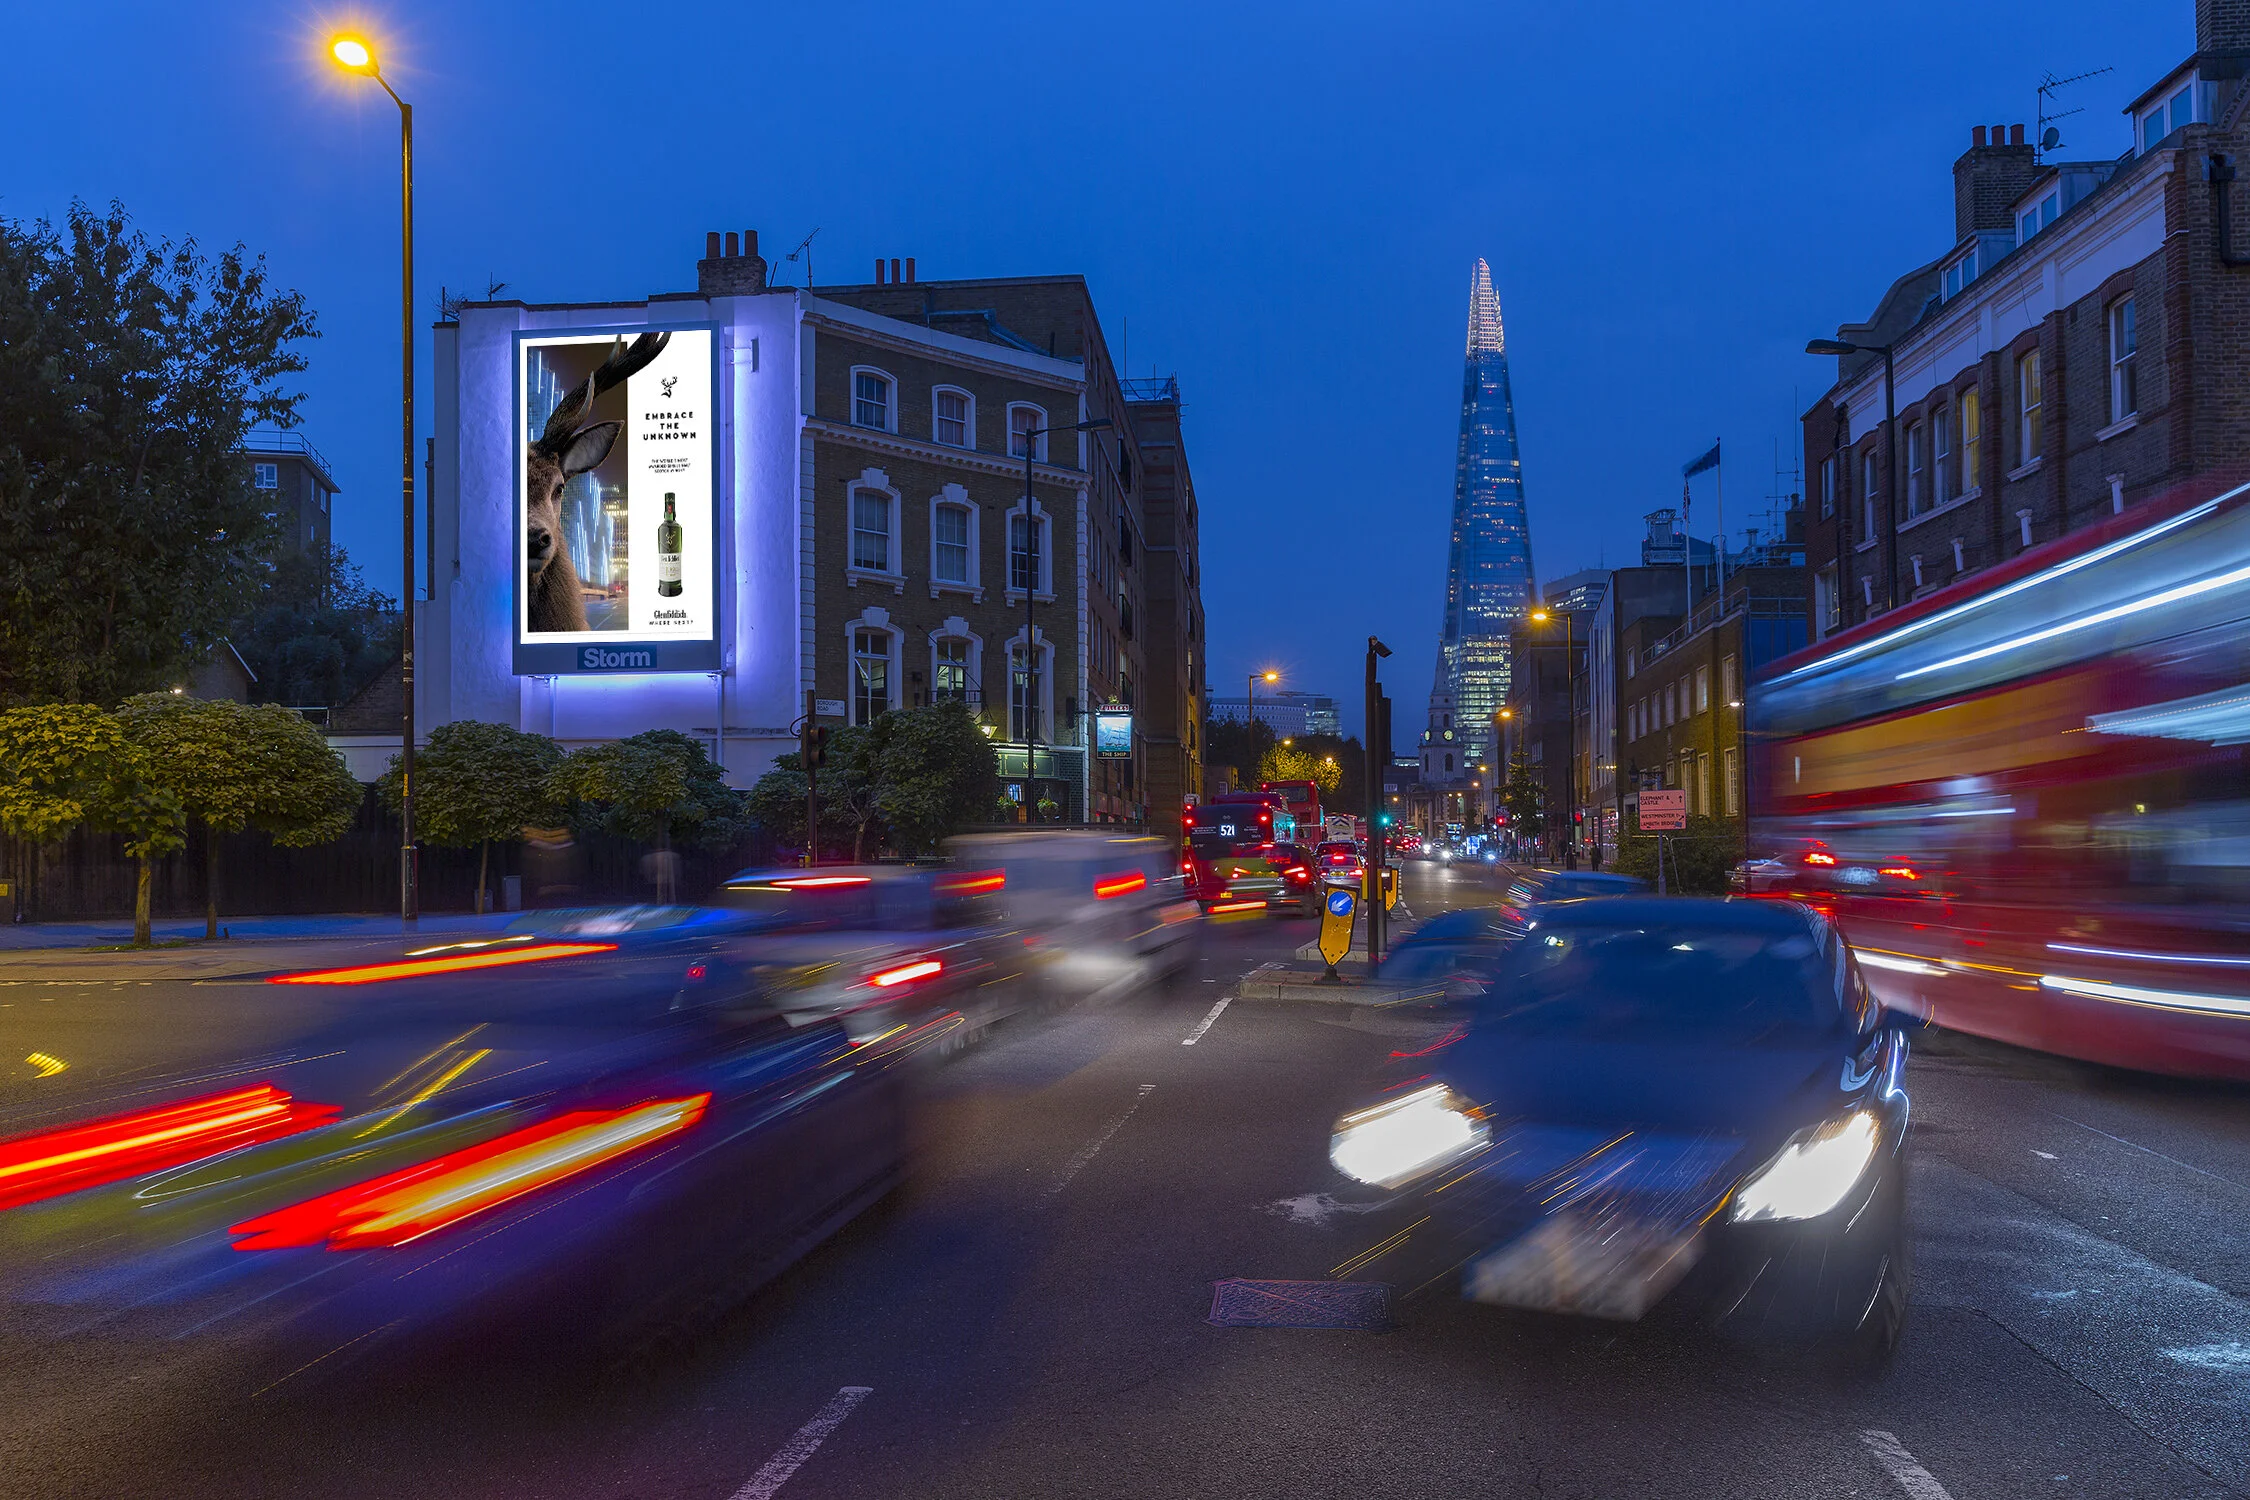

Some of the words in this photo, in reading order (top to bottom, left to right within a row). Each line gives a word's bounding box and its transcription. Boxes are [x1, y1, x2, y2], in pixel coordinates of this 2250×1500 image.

[645, 411, 694, 420] EMBRACE
[660, 422, 680, 430] THE
[643, 432, 697, 441] UNKNOWN
[583, 647, 651, 668] Storm
[1220, 825, 1235, 836] 521
